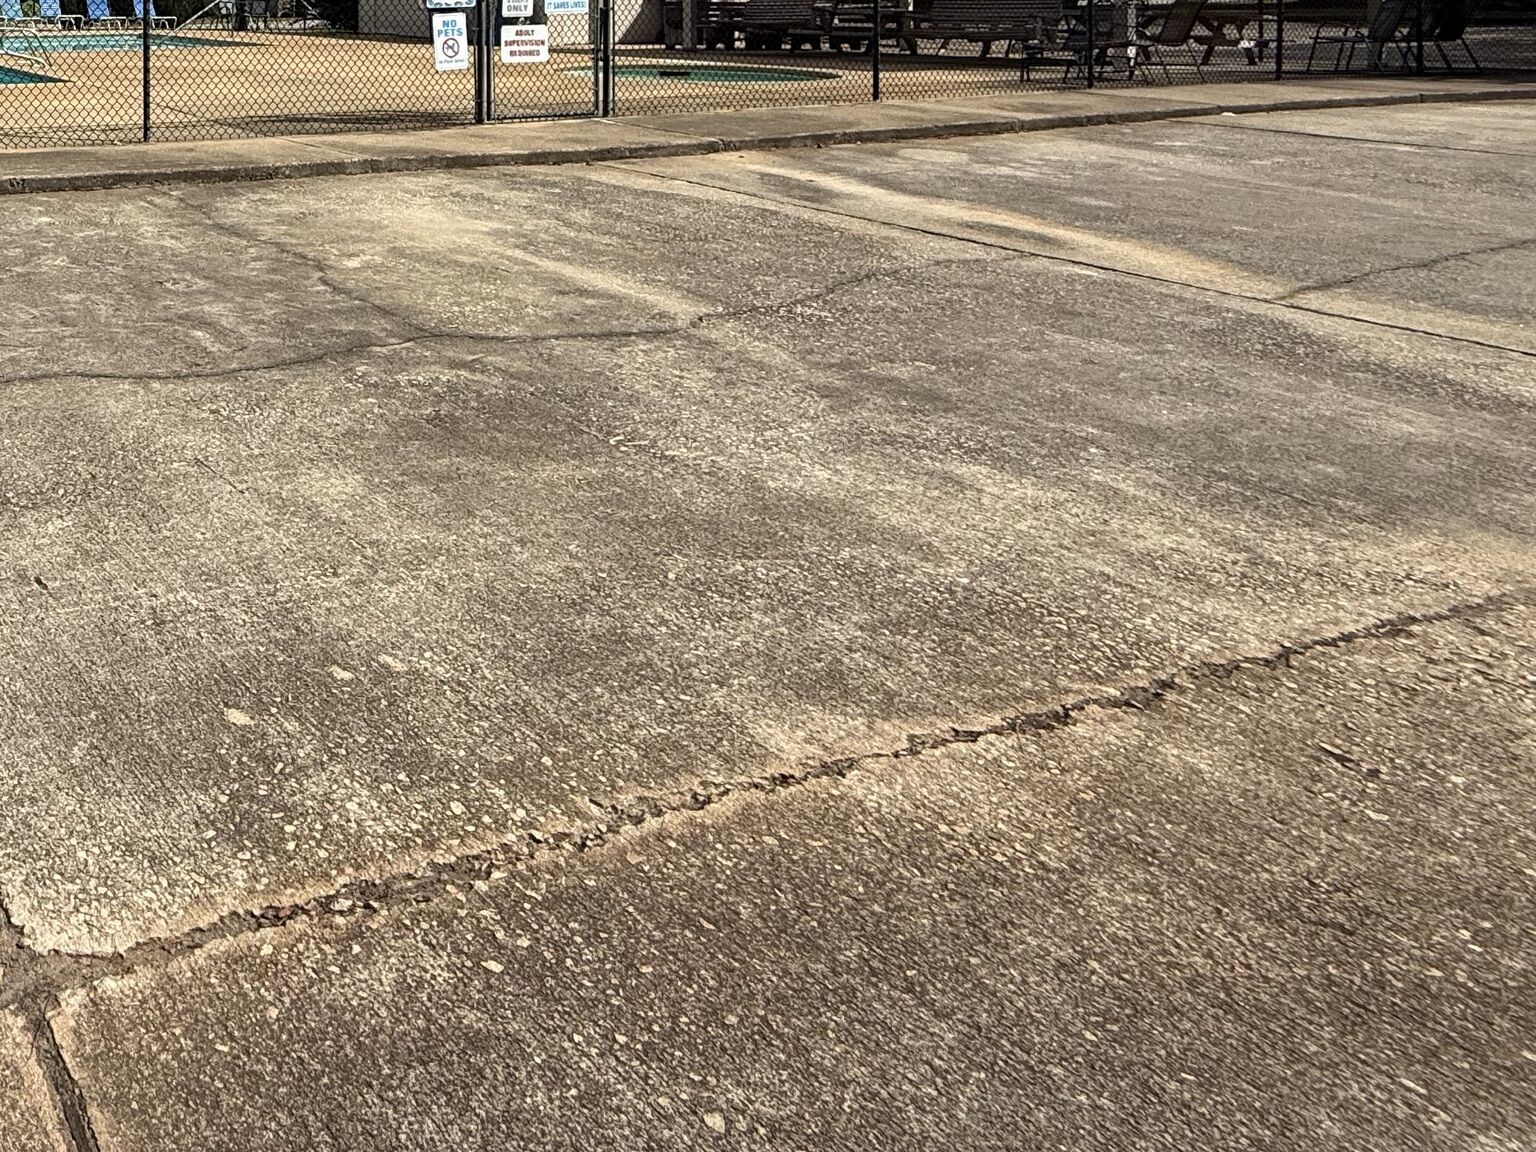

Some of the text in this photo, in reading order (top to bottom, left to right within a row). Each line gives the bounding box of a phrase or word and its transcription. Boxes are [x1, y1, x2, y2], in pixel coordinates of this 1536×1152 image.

[507, 4, 528, 12] ONLY
[553, 1, 570, 9] SAVES
[442, 19, 457, 28] NO
[437, 28, 463, 38] PETS
[504, 39, 545, 47] SUPERVISION
[509, 49, 540, 57] REQUIRED
